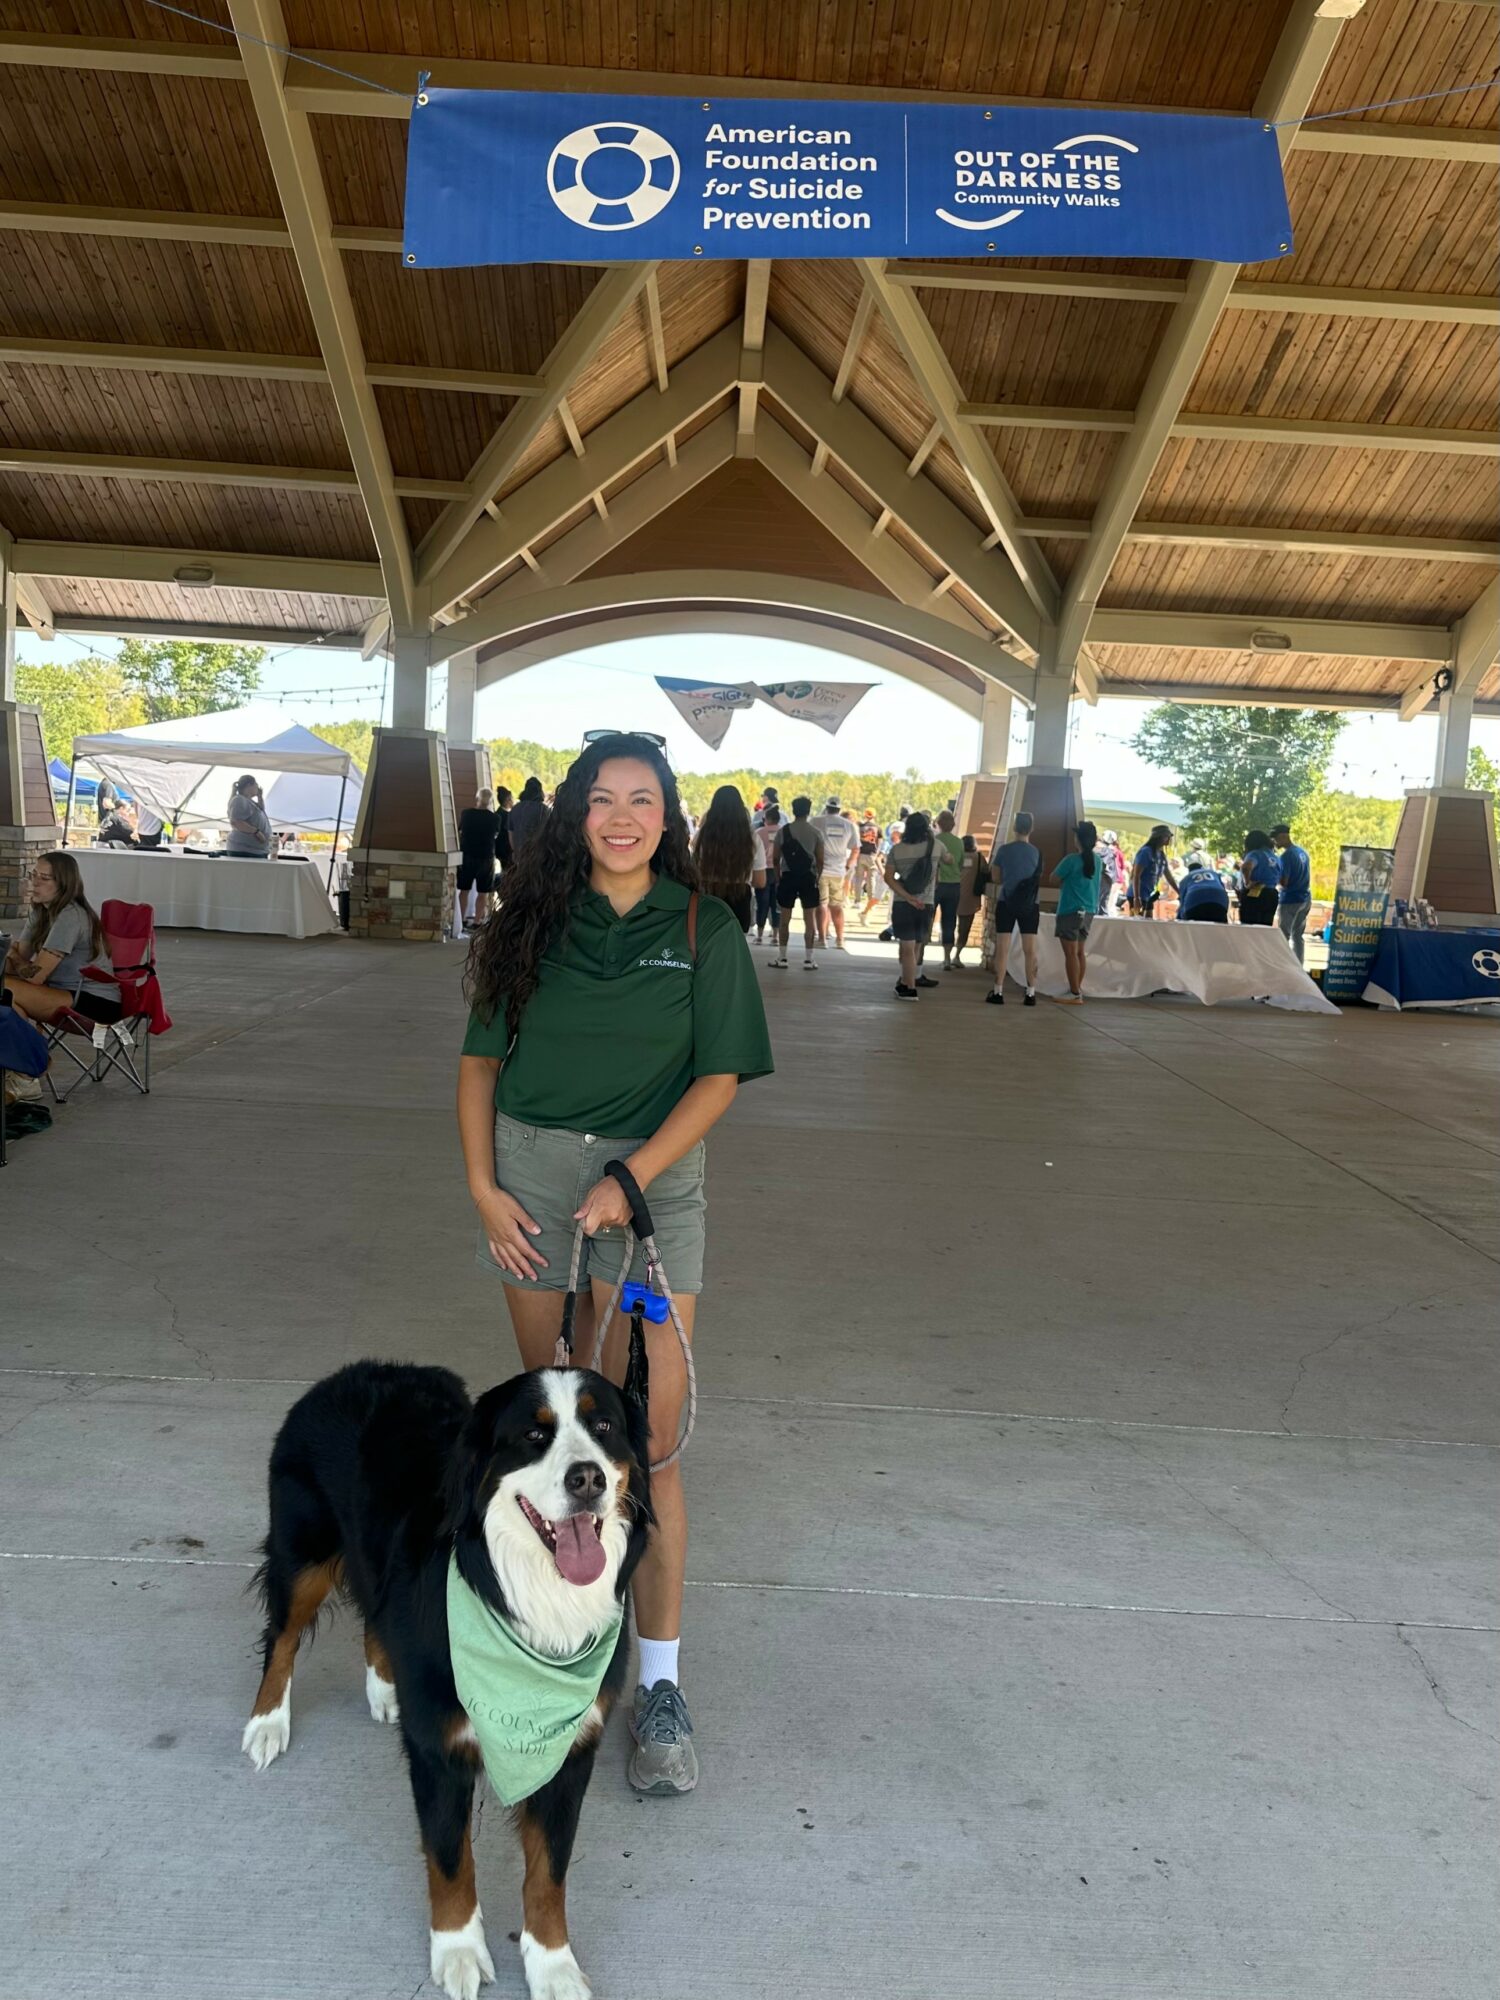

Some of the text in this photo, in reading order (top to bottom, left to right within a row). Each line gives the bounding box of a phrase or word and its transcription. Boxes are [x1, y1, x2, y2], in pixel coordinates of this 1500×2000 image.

[705, 124, 851, 145] American
[705, 150, 878, 172] Foundation
[954, 150, 1120, 171] OUT OF THE
[702, 178, 864, 200] for Suicide
[956, 170, 1122, 190] DARKNESS
[954, 191, 1121, 208] Community Walks
[702, 207, 872, 229] Prevention
[1338, 896, 1383, 912] Walk to
[1336, 912, 1383, 929] Prevent
[649, 960, 691, 970] COUNSELING
